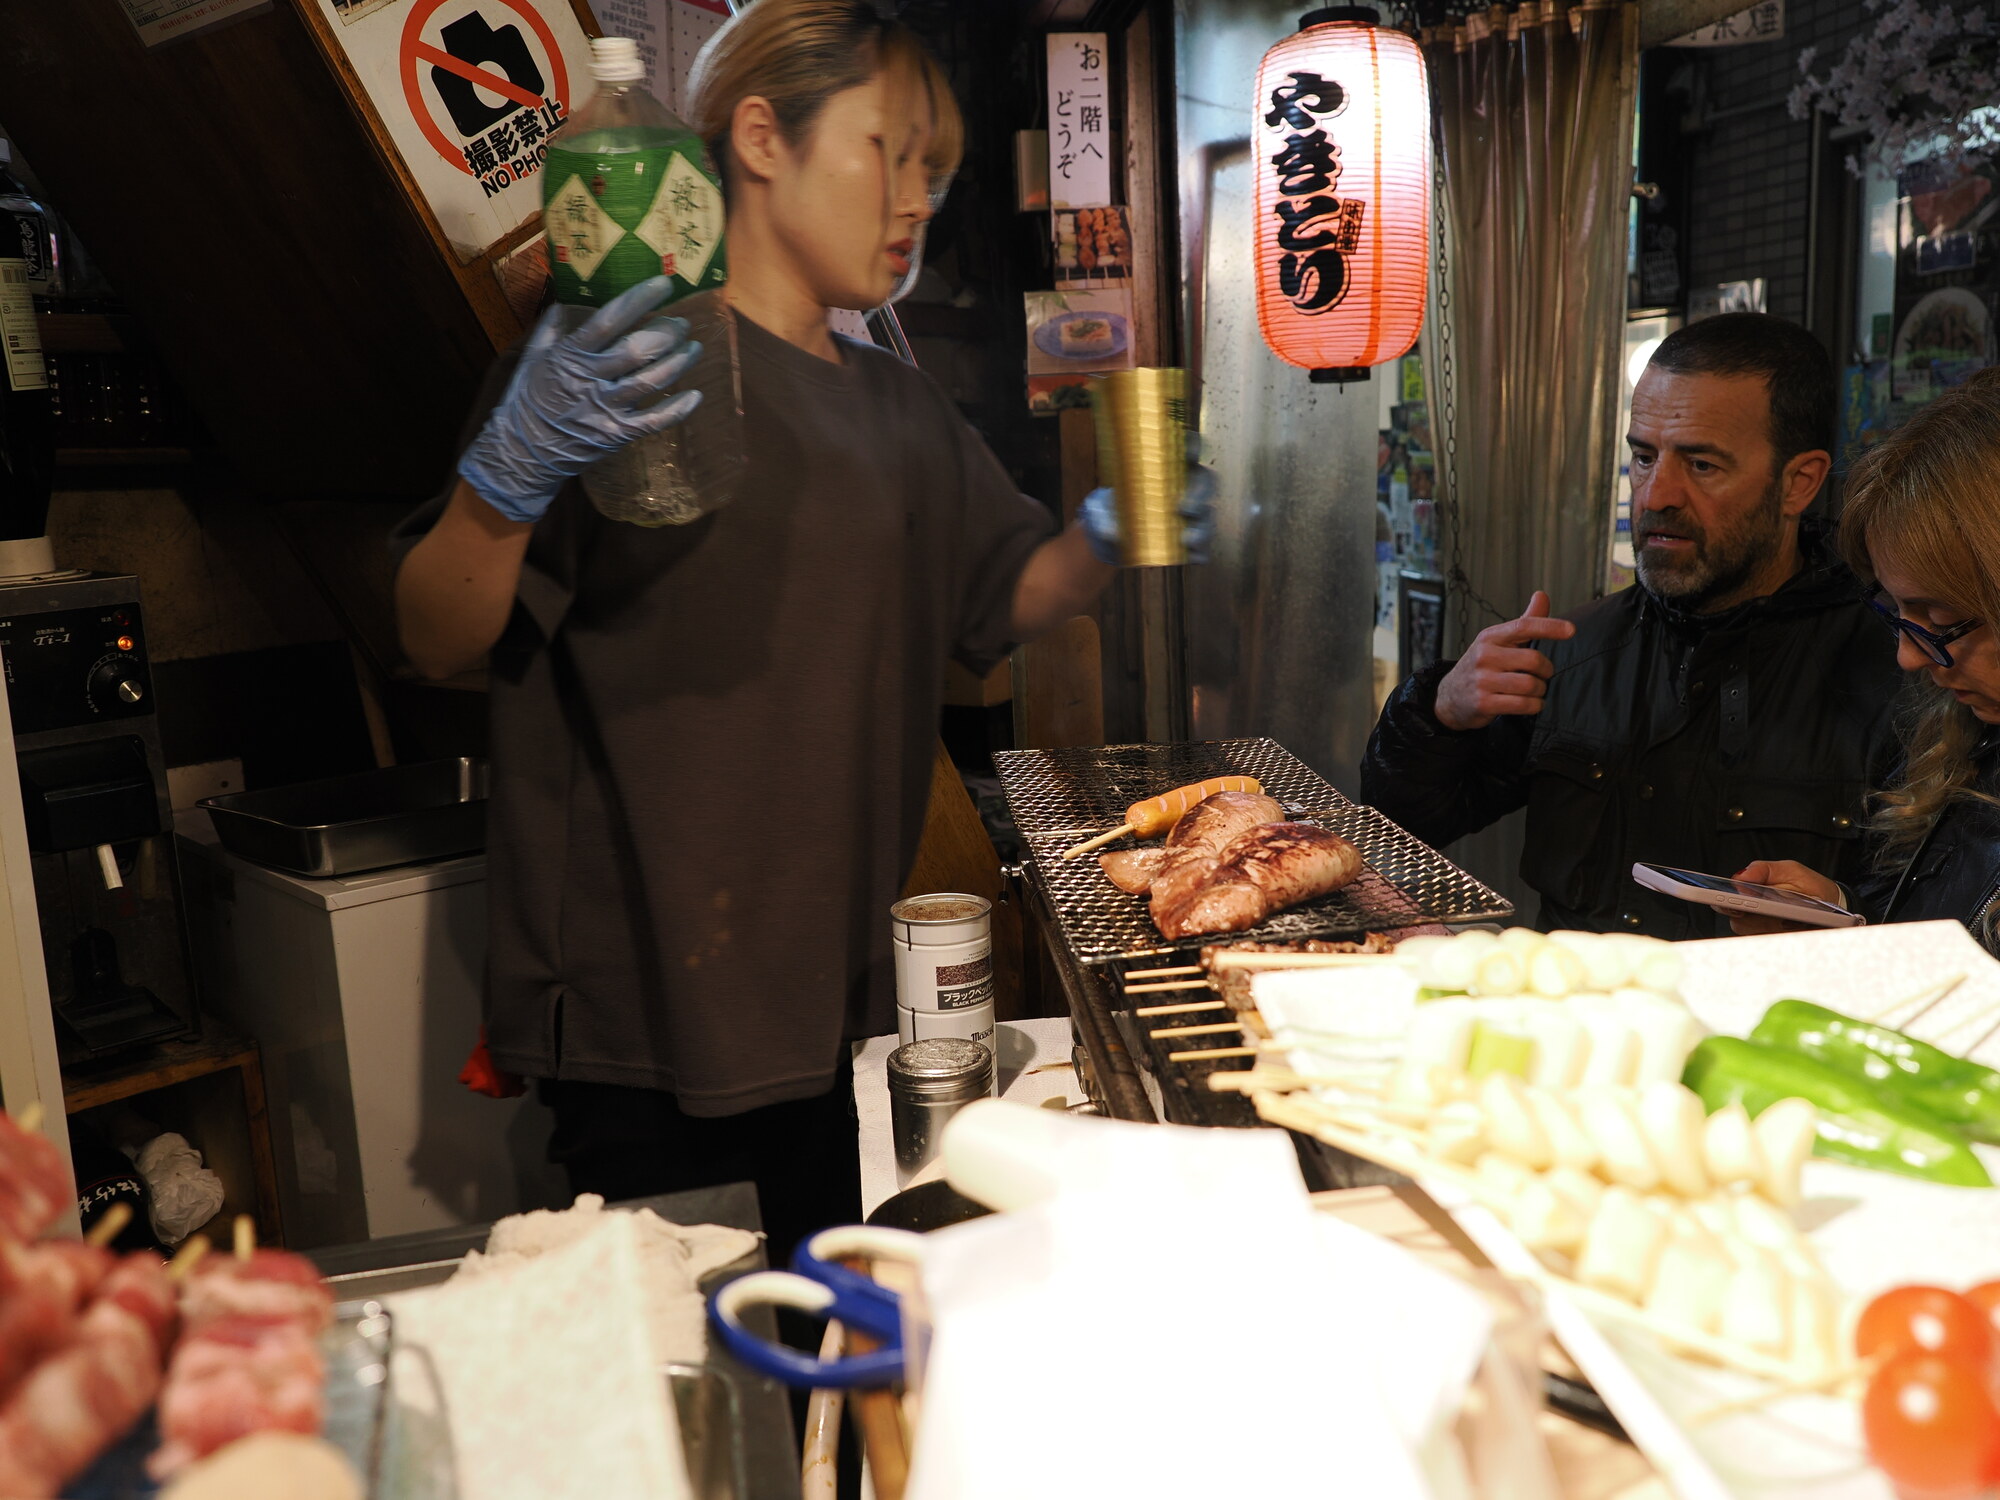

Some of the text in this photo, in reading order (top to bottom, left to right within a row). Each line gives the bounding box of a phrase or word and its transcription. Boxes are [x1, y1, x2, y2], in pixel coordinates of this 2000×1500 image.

[1056, 90, 1076, 179] どうぞ
[1079, 44, 1103, 159] お二階へ
[463, 97, 568, 179] 撮影禁止
[480, 142, 550, 199] NO PHO
[1265, 71, 1350, 315] やきとり
[33, 633, 72, 647] Ti-1
[943, 981, 993, 1003] ブラックペッパ
[952, 1000, 970, 1008] BLACK
